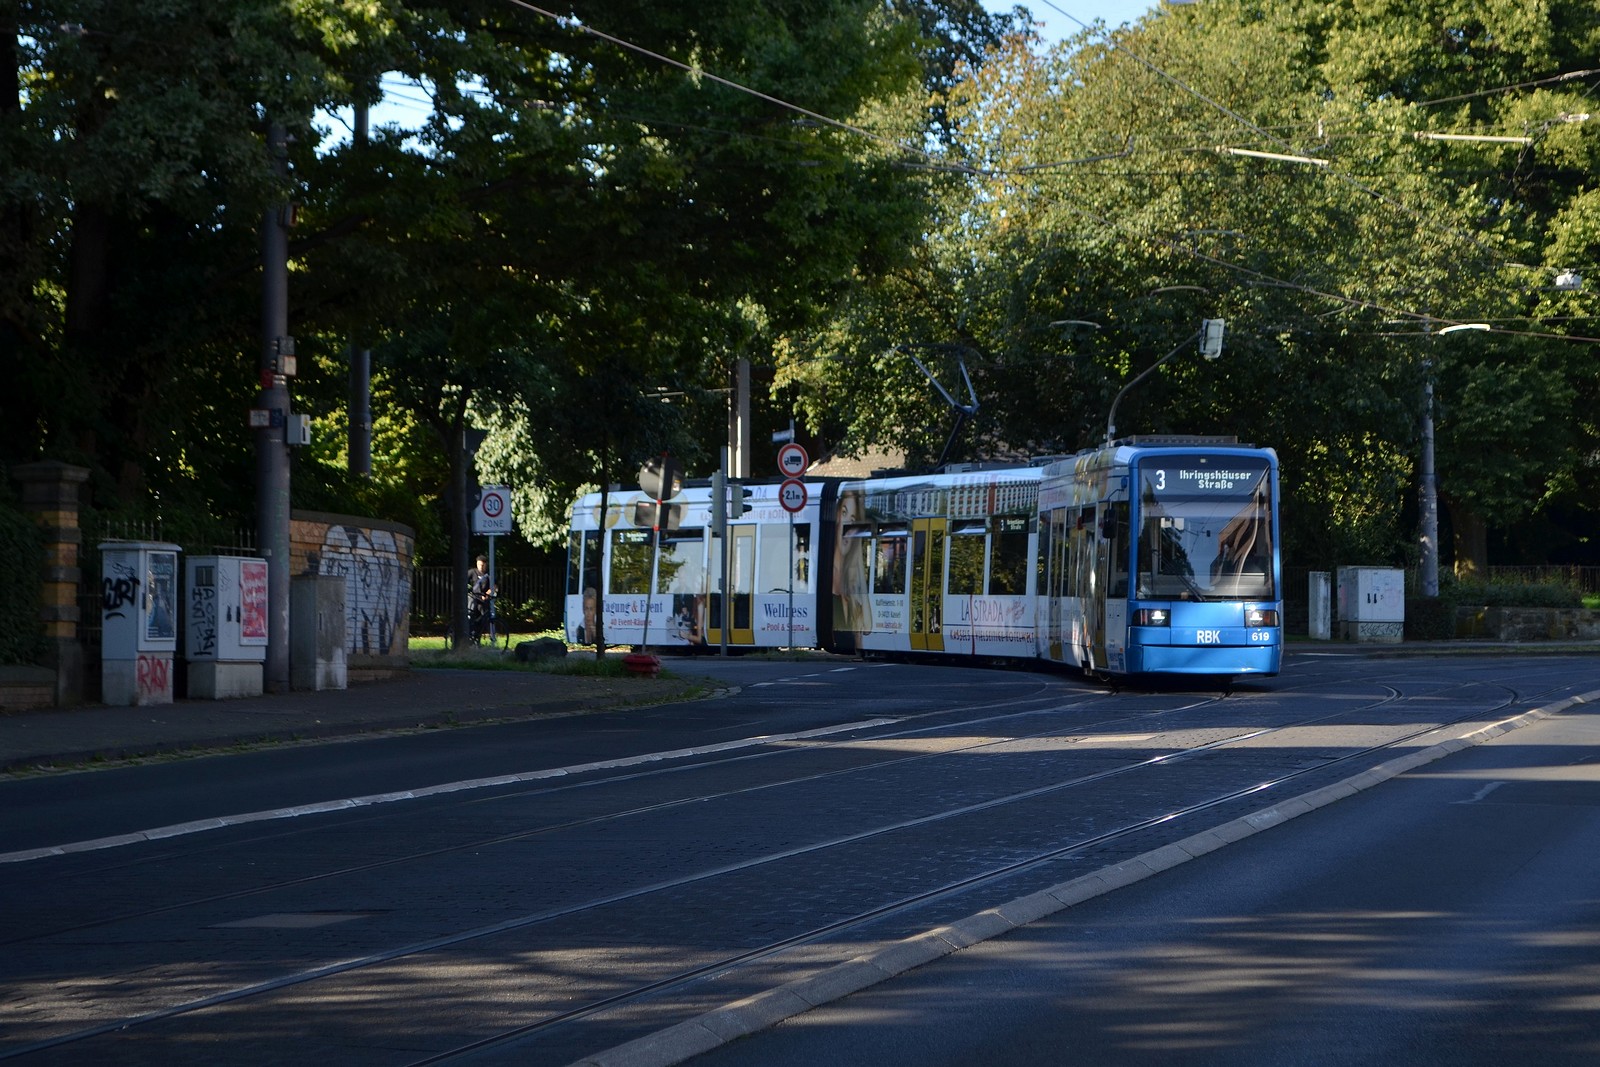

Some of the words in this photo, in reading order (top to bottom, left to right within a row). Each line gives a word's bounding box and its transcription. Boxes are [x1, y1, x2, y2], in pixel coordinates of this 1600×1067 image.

[1155, 469, 1166, 490] 3
[1179, 469, 1252, 480] Ihringshäuser
[1198, 479, 1234, 490] Straße
[486, 499, 500, 511] 30
[482, 519, 504, 528] ZONE
[631, 600, 638, 613] &
[973, 599, 1004, 622] STRADA
[766, 622, 780, 632] Pool
[1196, 630, 1221, 644] RBK
[1251, 632, 1270, 642] 619
